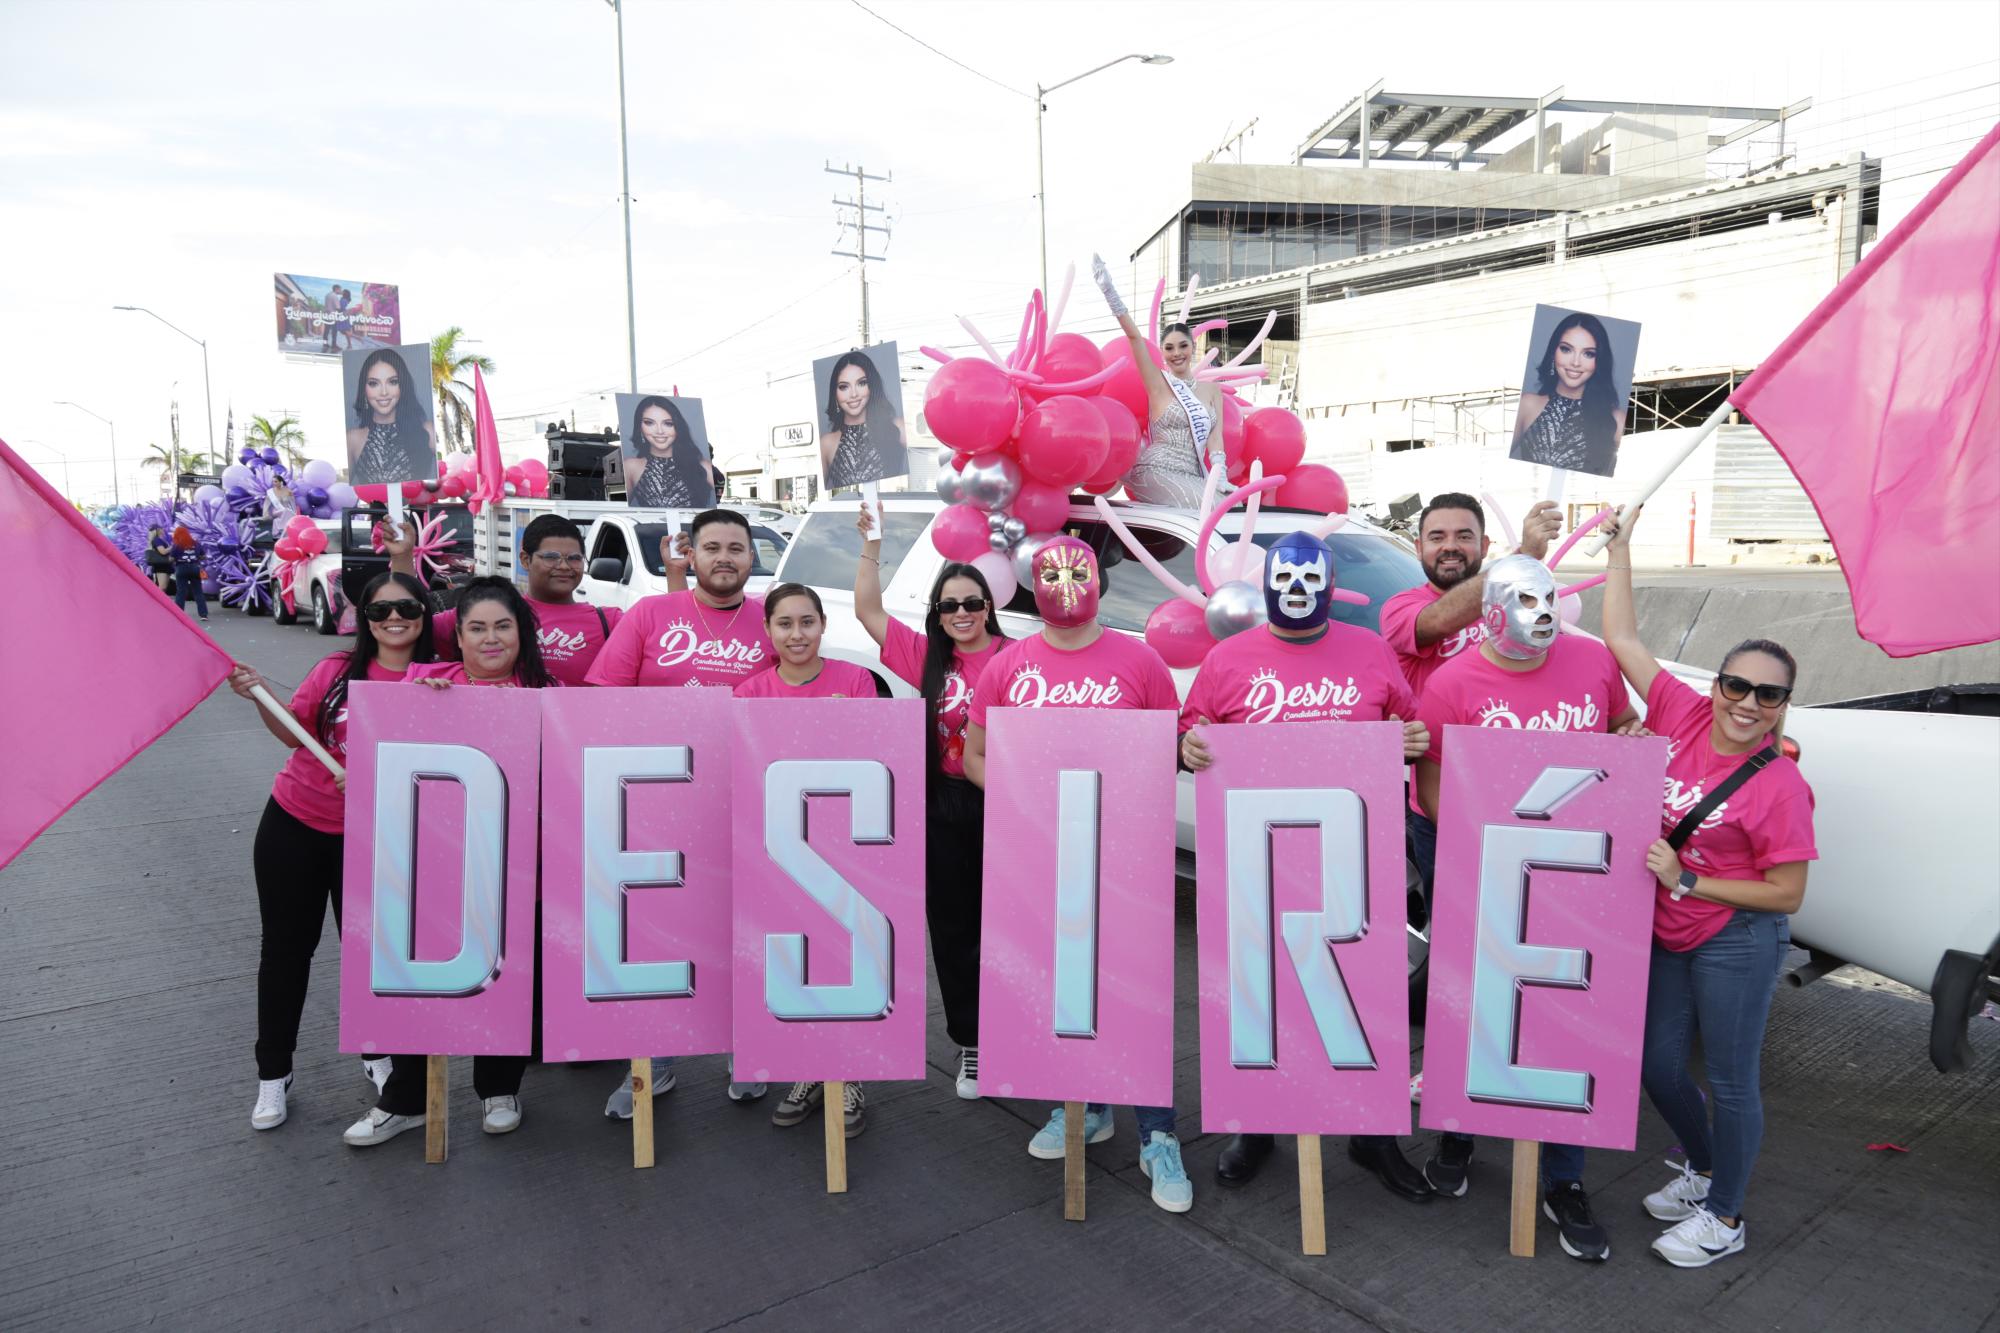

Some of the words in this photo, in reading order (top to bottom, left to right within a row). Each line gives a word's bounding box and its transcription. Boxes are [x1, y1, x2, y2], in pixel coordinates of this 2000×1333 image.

[283, 305, 349, 327] Guanajuato
[349, 314, 394, 326] provoca
[536, 627, 587, 651] siré
[657, 628, 765, 668] Desiré
[1009, 674, 1122, 708] Desiré
[1244, 677, 1362, 723] Desiré
[1282, 709, 1321, 721] Candidata
[1329, 707, 1353, 719] Reina
